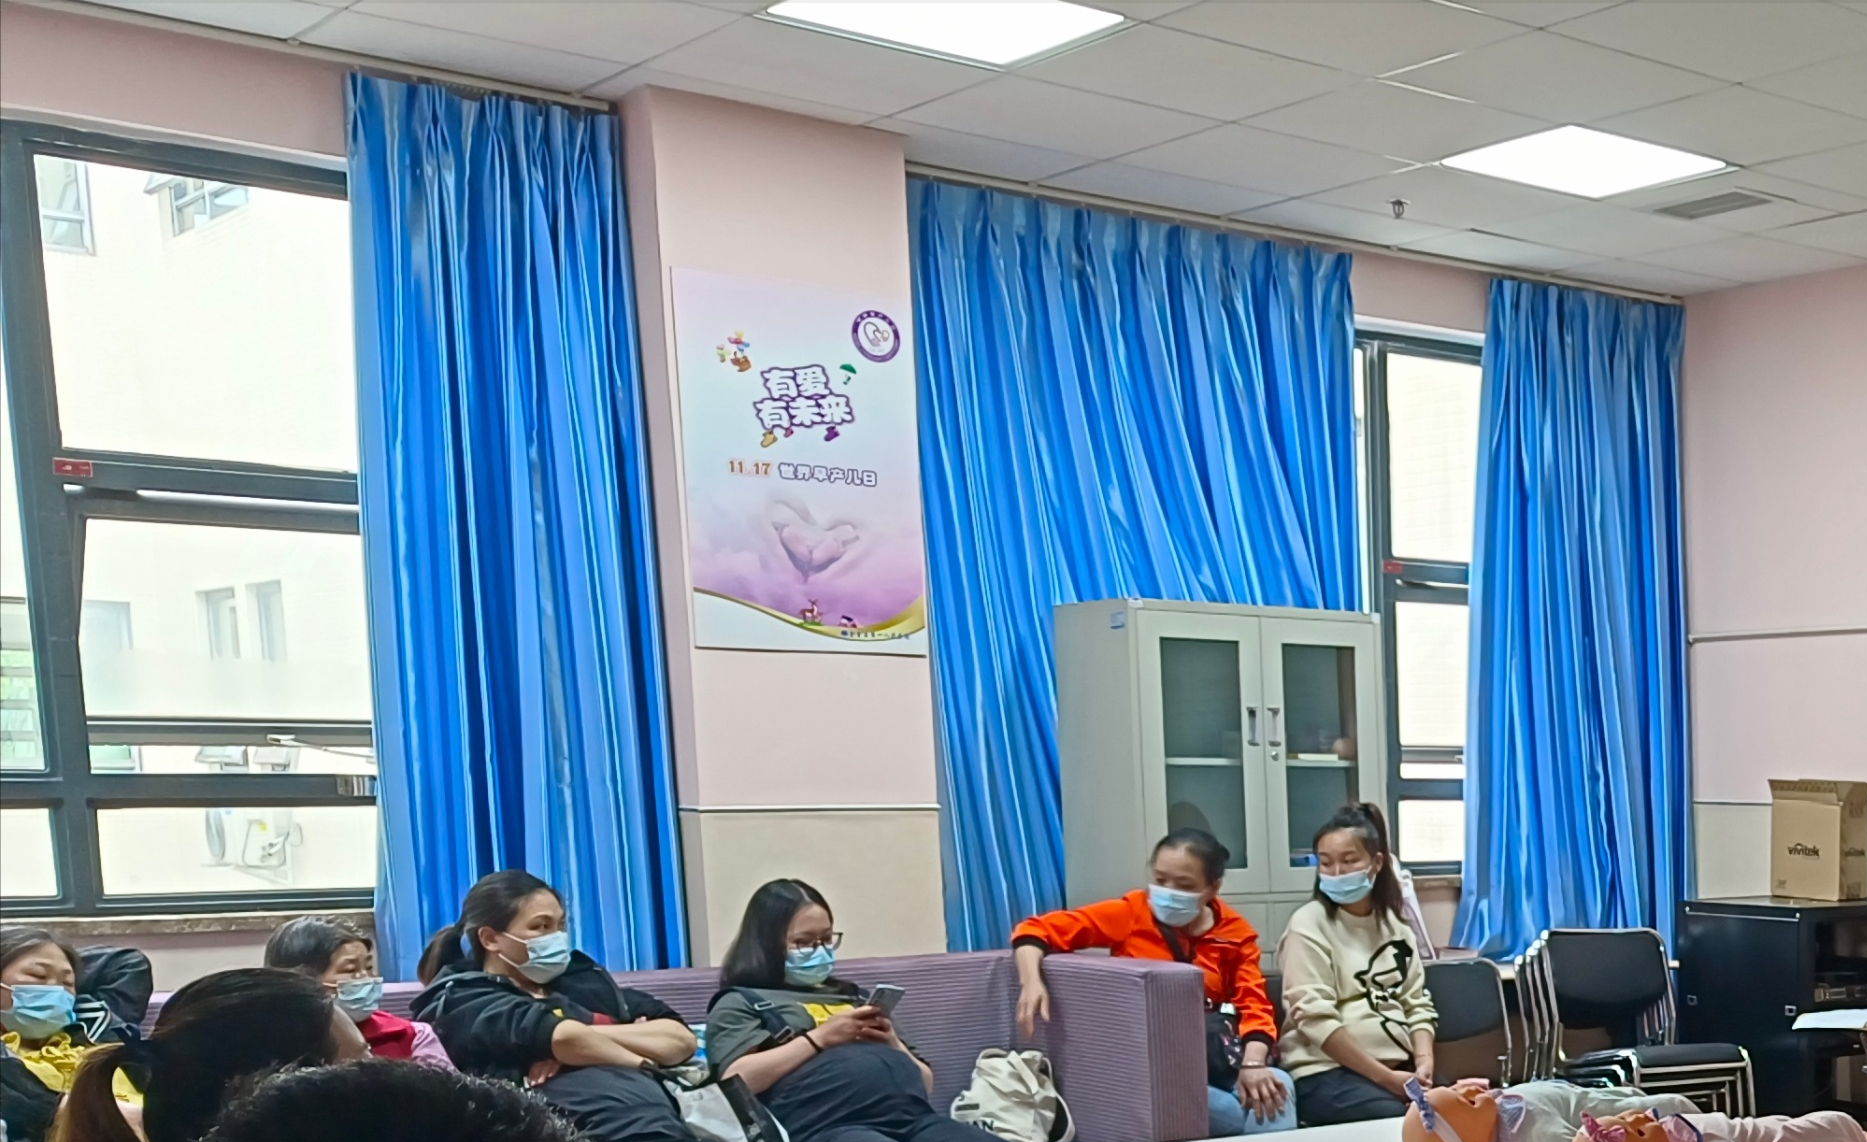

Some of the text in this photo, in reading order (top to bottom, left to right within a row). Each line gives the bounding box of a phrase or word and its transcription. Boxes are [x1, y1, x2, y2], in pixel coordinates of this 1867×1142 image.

[761, 364, 831, 399] 有爱
[753, 394, 854, 429] 有未来
[728, 460, 877, 487] 11.17 世界早产儿日
[1787, 843, 1820, 857] vivitek
